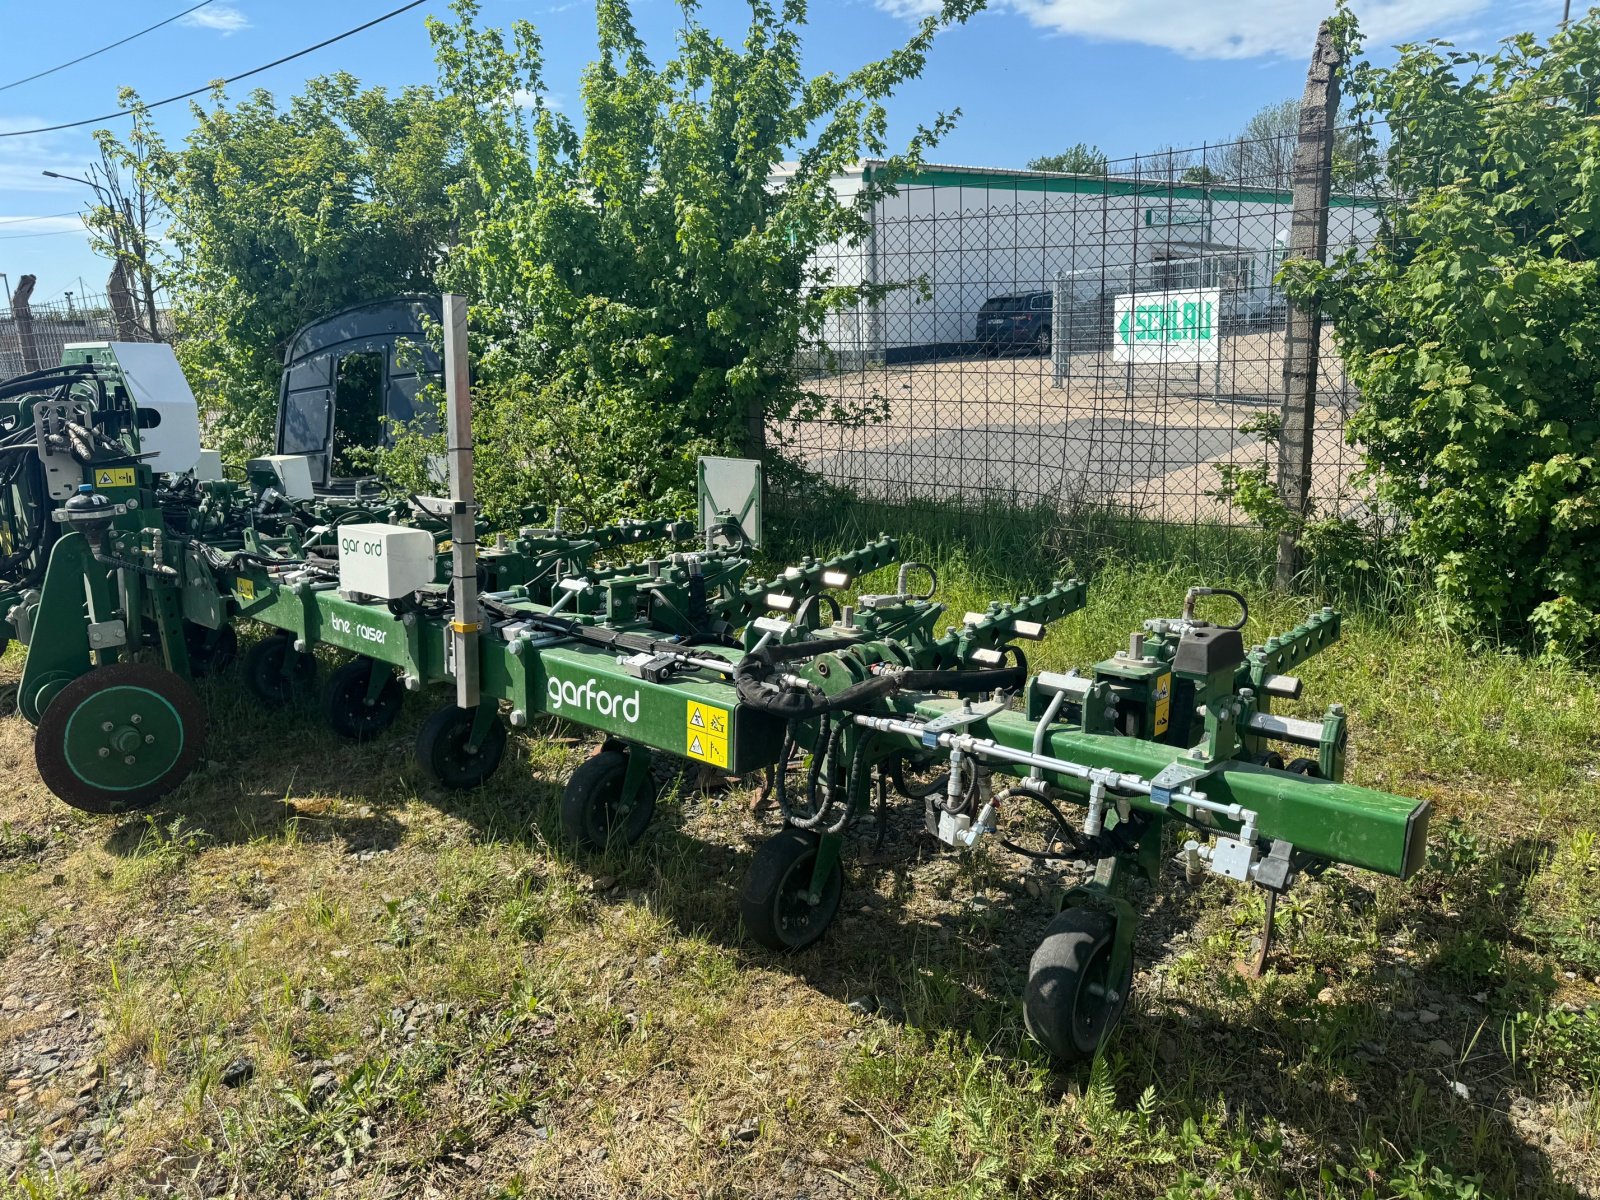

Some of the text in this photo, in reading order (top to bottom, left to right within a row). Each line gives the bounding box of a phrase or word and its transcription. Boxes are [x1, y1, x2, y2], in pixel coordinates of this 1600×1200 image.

[331, 611, 387, 644] tine raiser
[548, 677, 640, 723] garford
